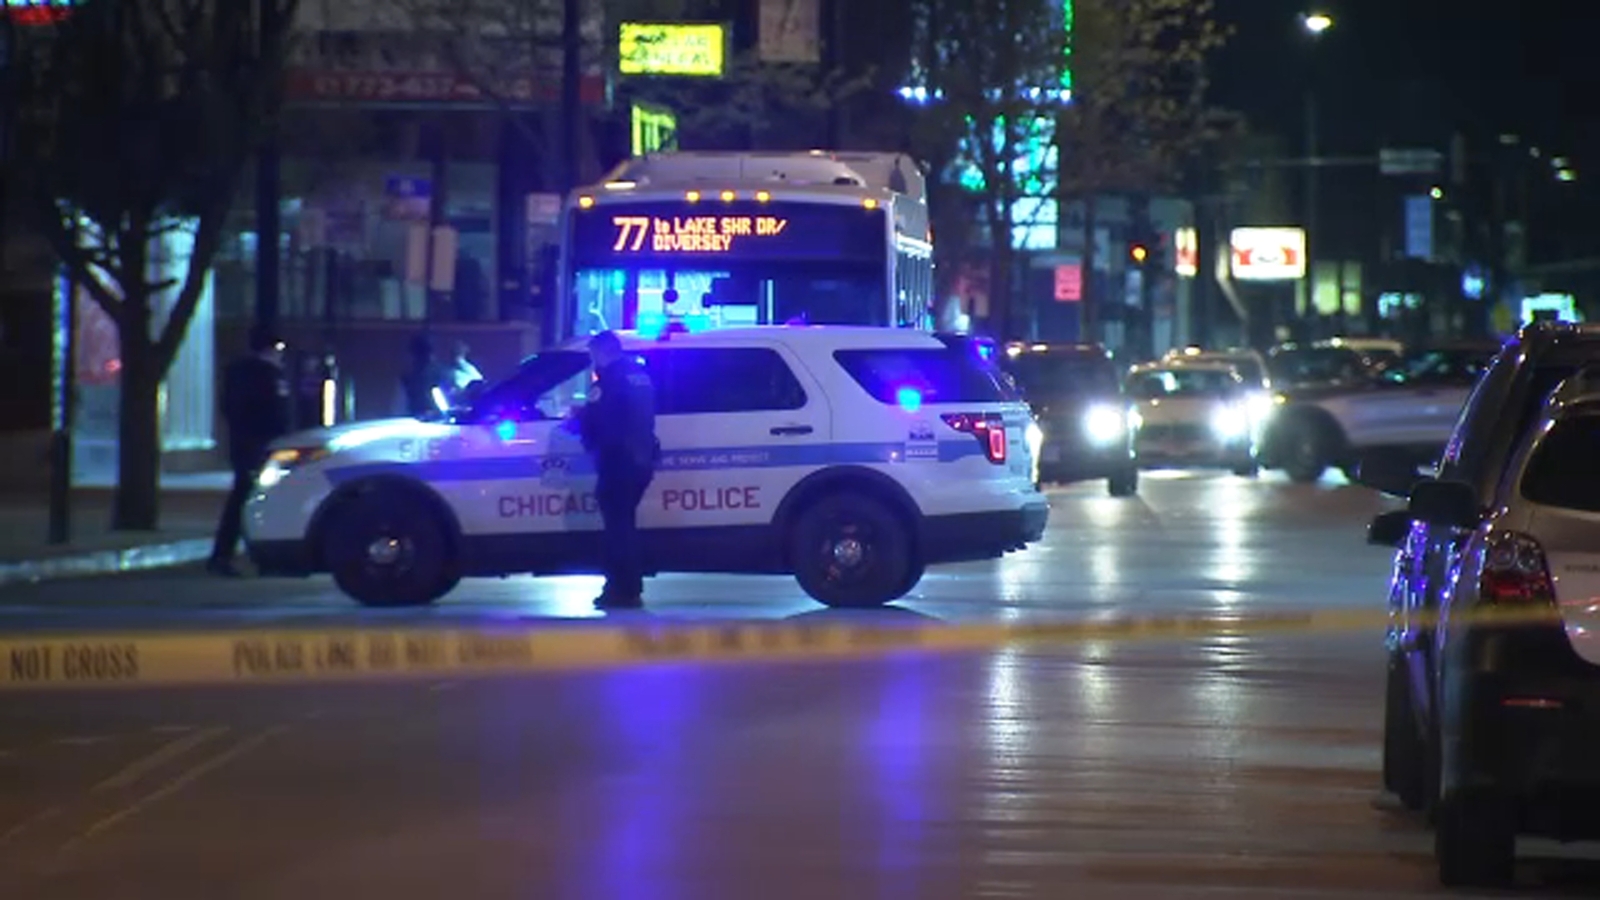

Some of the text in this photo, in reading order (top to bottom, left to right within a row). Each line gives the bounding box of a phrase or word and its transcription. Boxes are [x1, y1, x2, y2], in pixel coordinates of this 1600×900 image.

[613, 216, 649, 251] 77
[654, 217, 787, 235] to LAKE SHR DR/
[653, 234, 731, 251] DIVERSEY
[498, 493, 598, 518] CHICAG
[661, 486, 761, 511] POLICE
[10, 642, 140, 682] NOT CROSS
